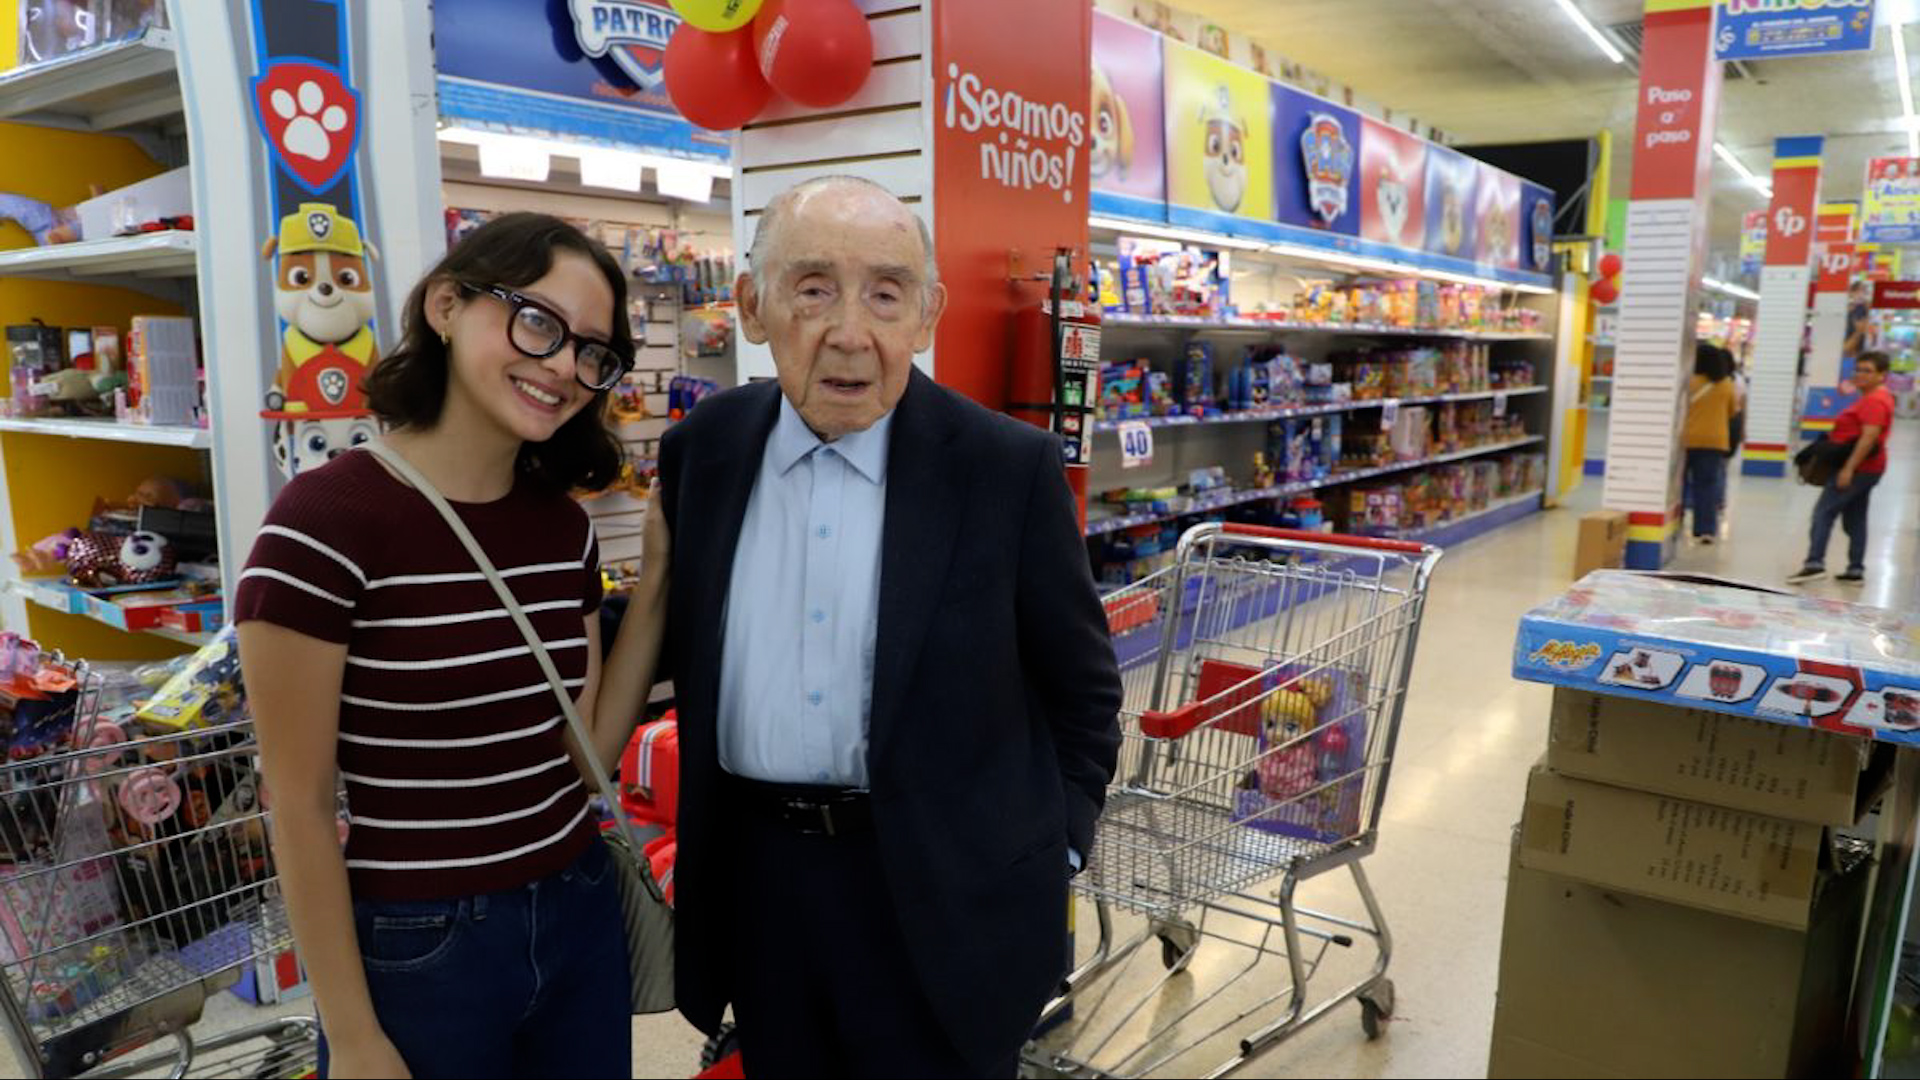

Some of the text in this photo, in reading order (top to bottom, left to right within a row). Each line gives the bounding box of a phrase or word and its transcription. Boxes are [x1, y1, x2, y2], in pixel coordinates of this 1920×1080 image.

[945, 62, 1084, 146] ¡Seamos
[1647, 86, 1692, 105] Paso
[1661, 111, 1674, 124] a
[1645, 130, 1691, 149] paso
[980, 131, 1076, 204] niños!
[1125, 430, 1148, 457] 40
